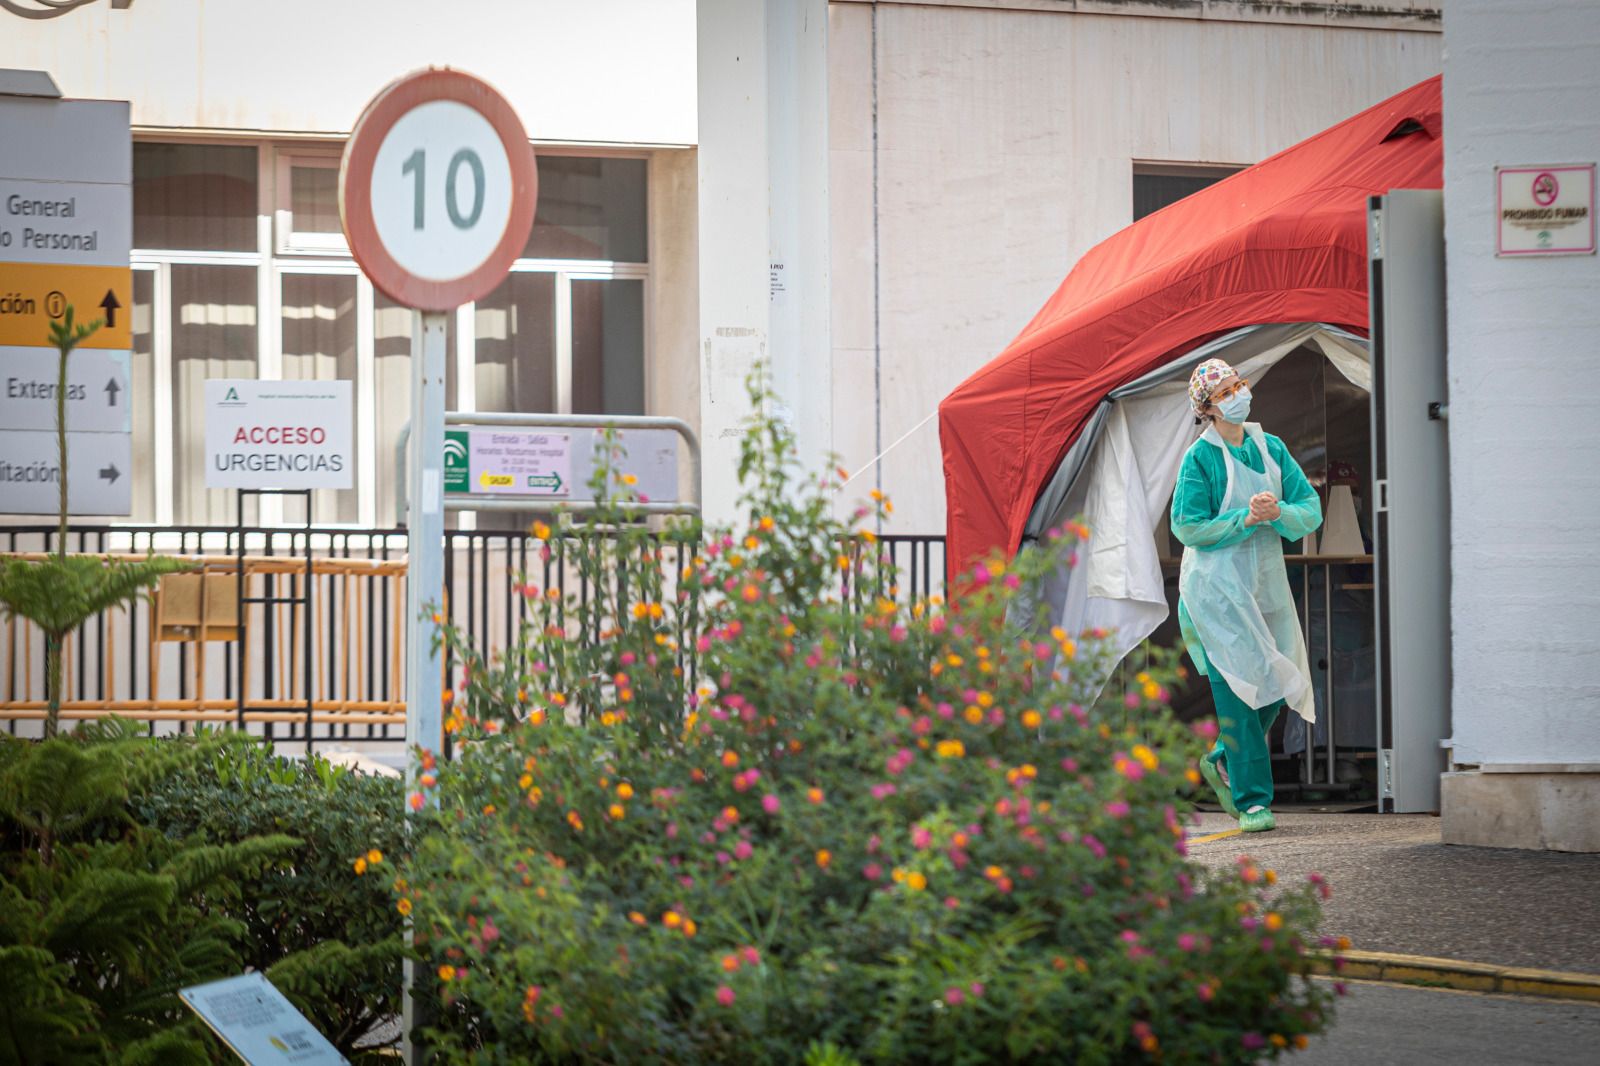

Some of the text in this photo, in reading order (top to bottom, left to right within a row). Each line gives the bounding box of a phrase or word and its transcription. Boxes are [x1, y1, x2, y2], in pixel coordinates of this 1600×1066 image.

[402, 147, 486, 231] 10
[7, 194, 75, 218] General
[1503, 207, 1588, 220] PROHIBIDO FUMAR
[0, 227, 98, 251] o Personal
[234, 427, 325, 444] ACCESO
[215, 453, 344, 472] URGENCIAS
